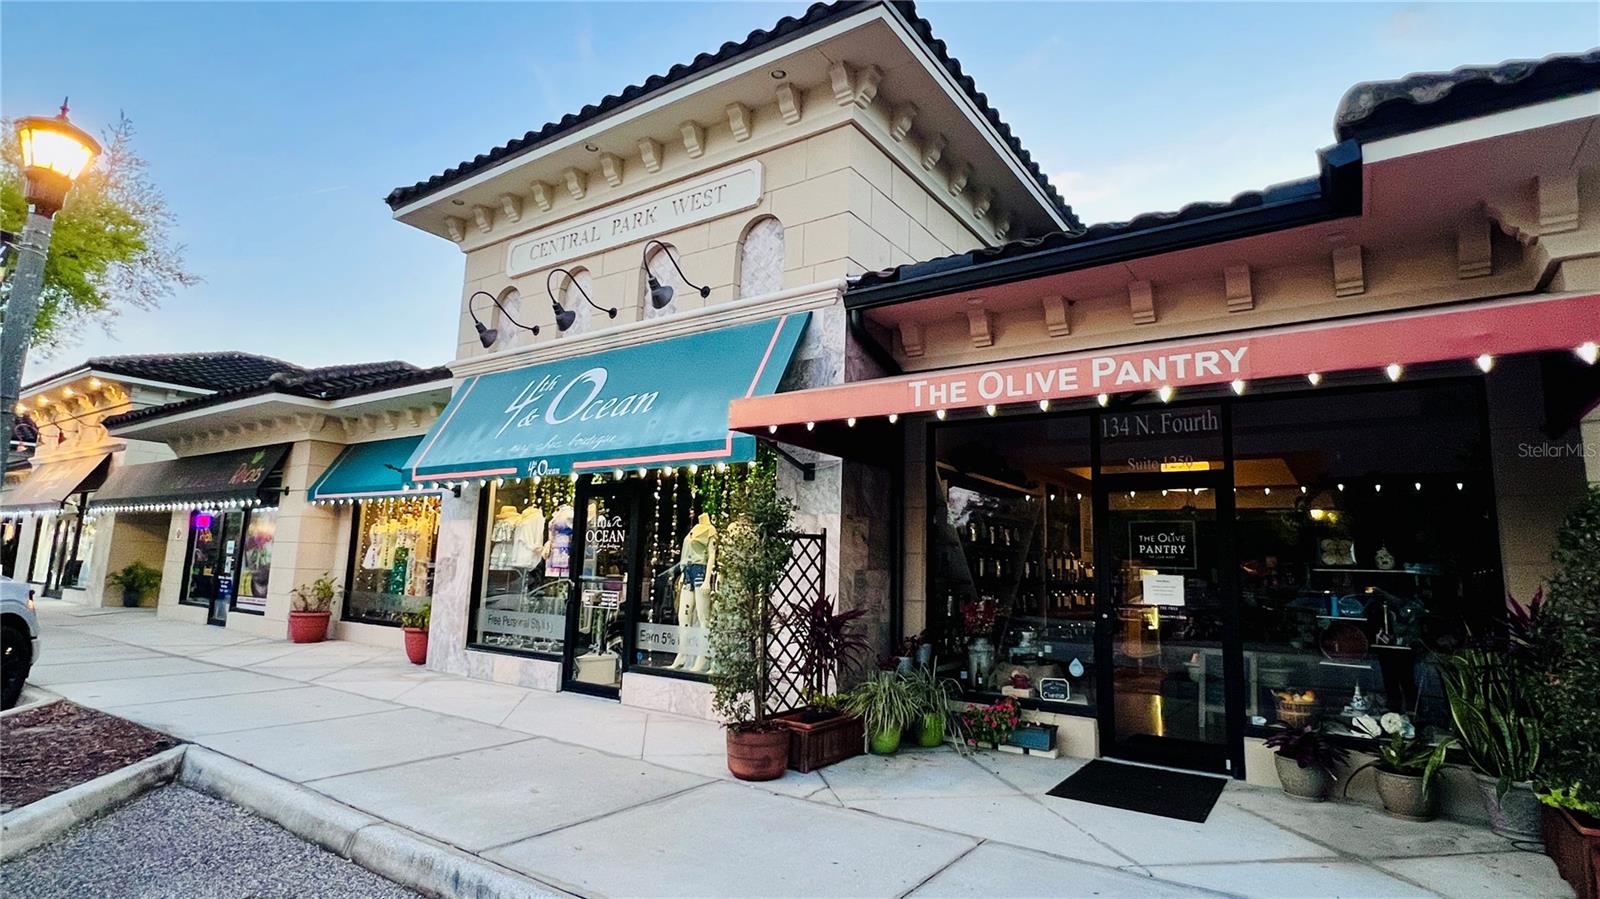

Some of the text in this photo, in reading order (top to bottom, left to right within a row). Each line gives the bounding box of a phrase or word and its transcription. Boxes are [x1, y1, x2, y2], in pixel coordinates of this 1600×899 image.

[529, 184, 728, 260] CENTRAL PARK WEST
[908, 347, 1249, 407] THE OLIVE PANTRY
[544, 367, 659, 425] Ocean
[1101, 409, 1218, 438] 134 N. Fourth
[1127, 457, 1159, 471] Suite
[585, 529, 626, 543] OCEAN
[1139, 545, 1186, 554] PANTRY
[487, 614, 502, 626] Free
[640, 629, 660, 644] Earn
[661, 631, 676, 646] 5%
